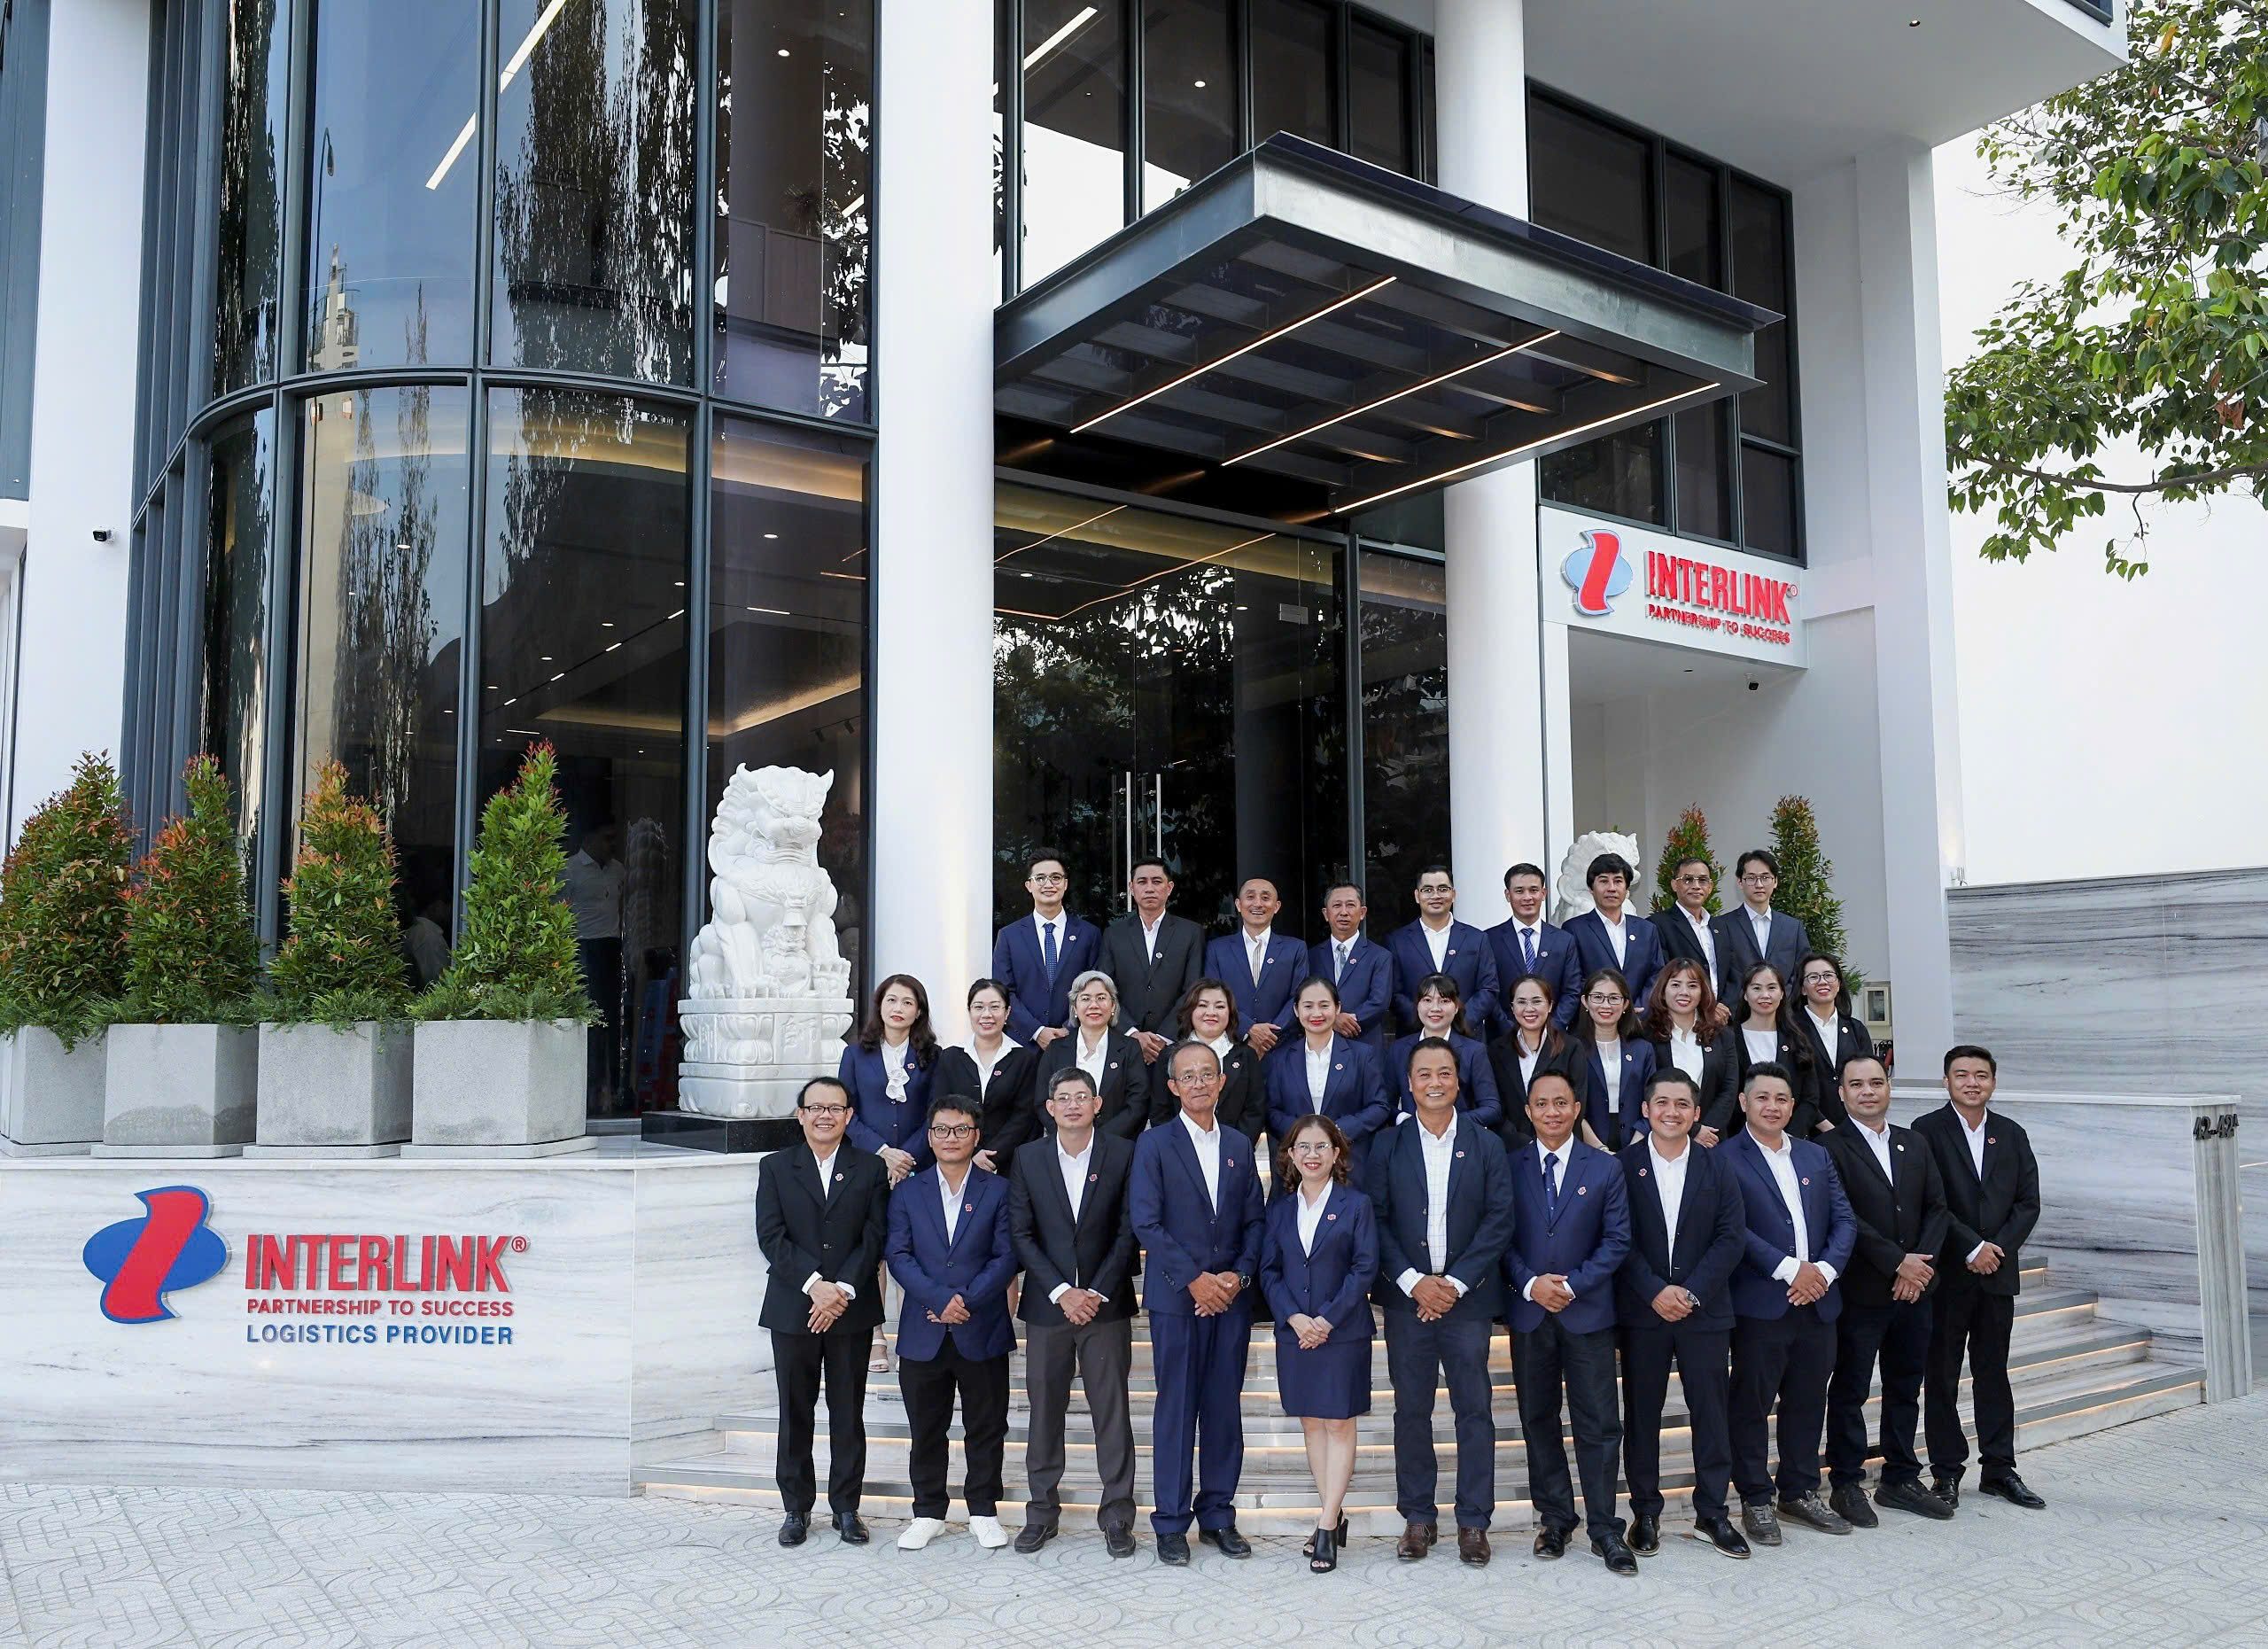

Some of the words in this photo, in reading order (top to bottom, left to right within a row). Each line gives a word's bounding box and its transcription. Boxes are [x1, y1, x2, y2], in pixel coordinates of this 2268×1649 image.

[1647, 603, 1721, 630] PARTNERSHIP
[1724, 619, 1739, 634] TO
[1742, 623, 1790, 644] SUCCESS
[247, 1299, 382, 1316] PARTNERSHIP
[388, 1300, 415, 1316] TO
[421, 1301, 515, 1317] SUCCESS
[246, 1325, 377, 1343] LOGISTICS
[386, 1326, 513, 1345] PROVIDER
